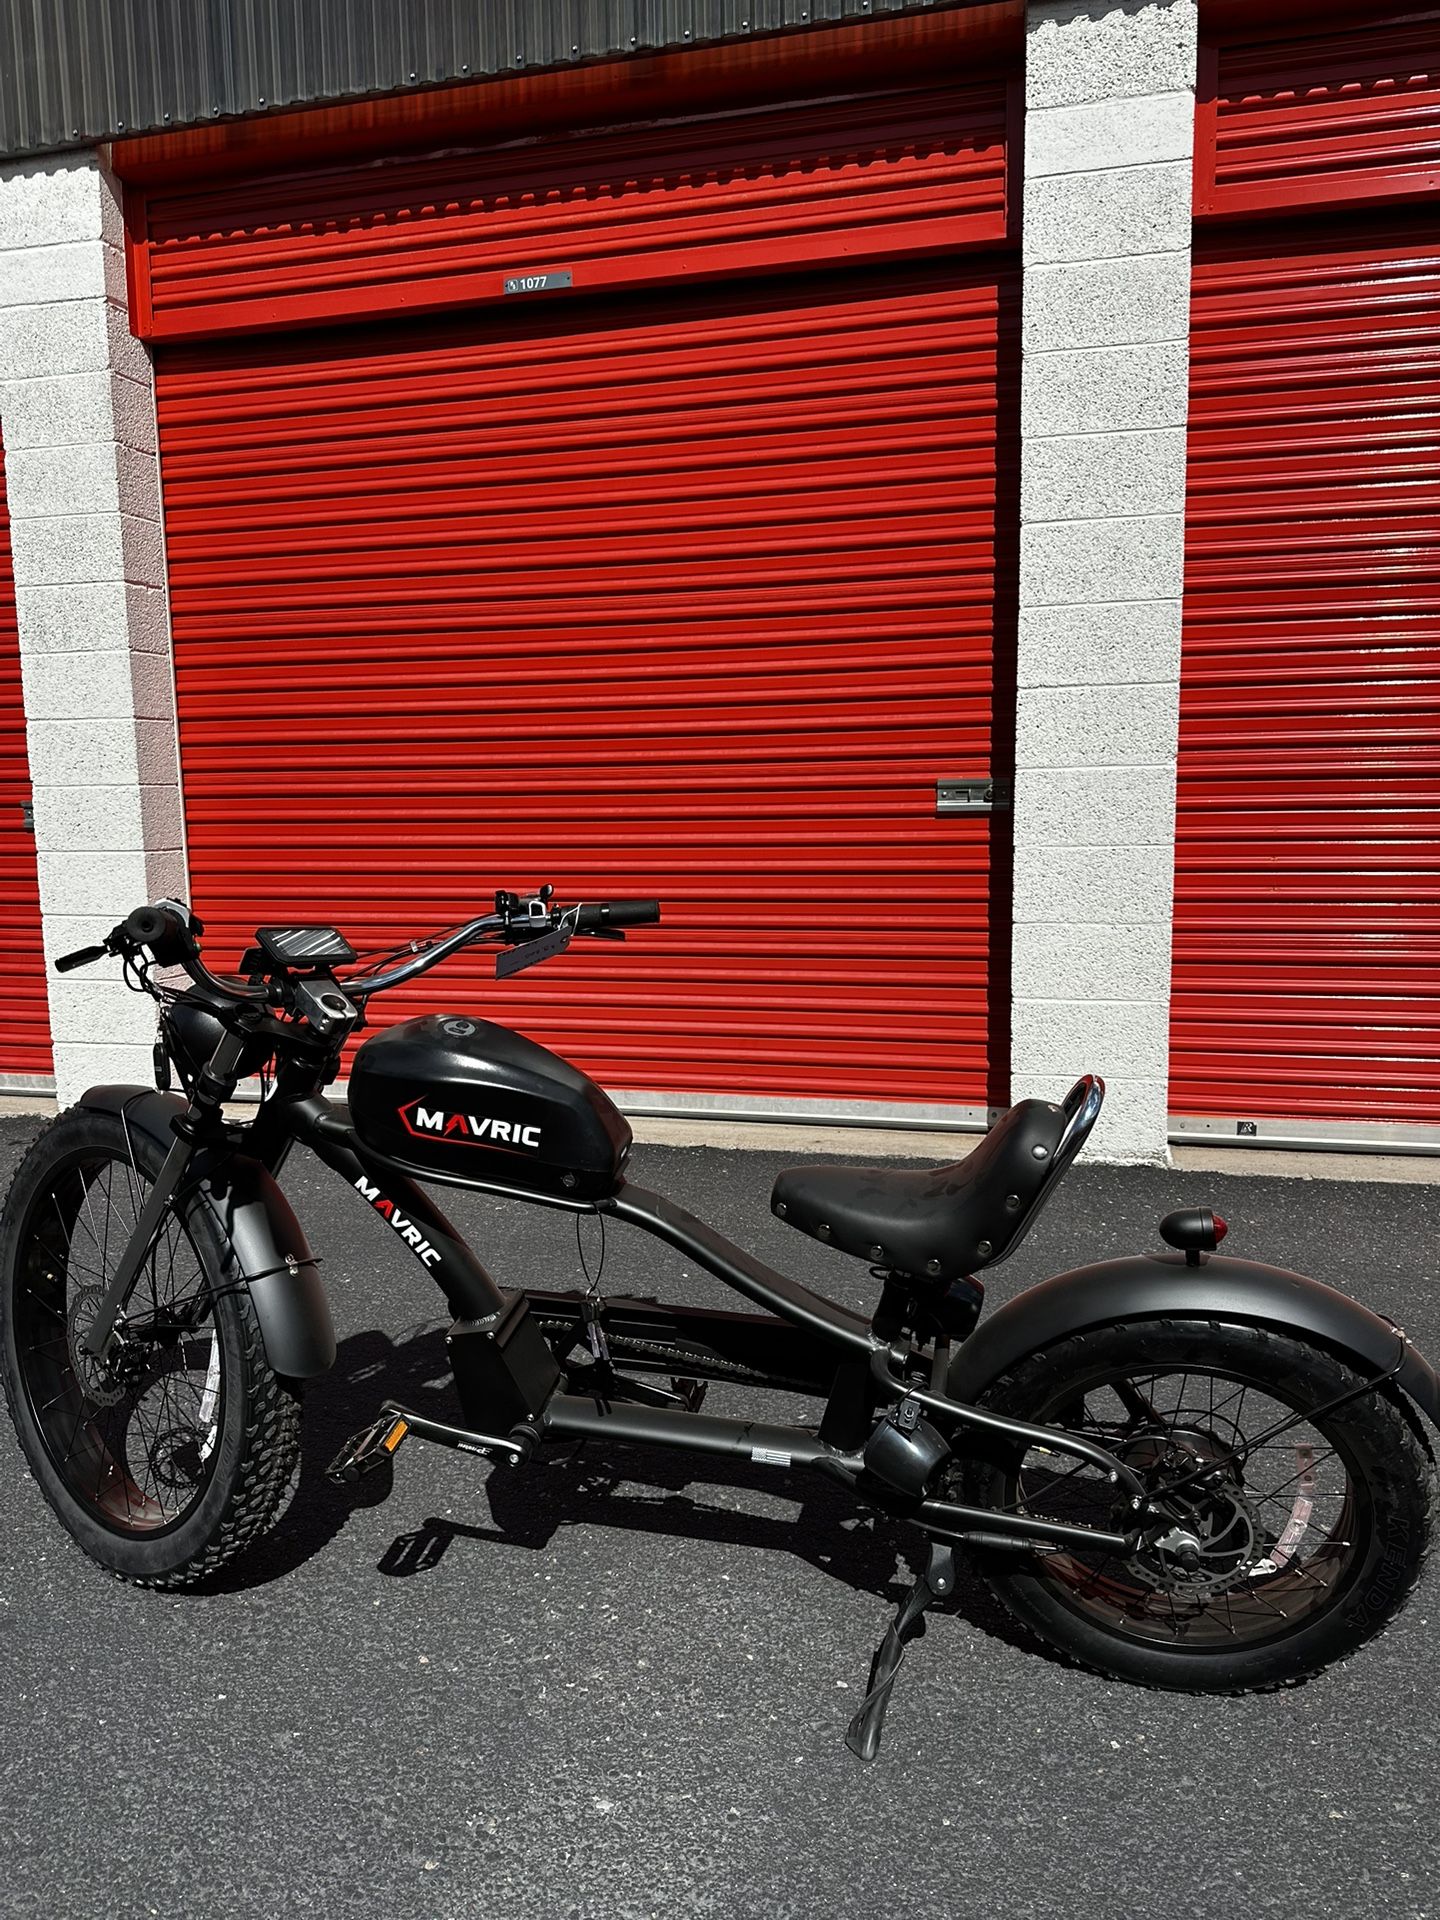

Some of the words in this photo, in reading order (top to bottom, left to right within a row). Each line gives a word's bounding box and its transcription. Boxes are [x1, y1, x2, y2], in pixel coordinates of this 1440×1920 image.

[520, 275, 547, 290] 1077
[415, 1107, 542, 1148] MAVRIC
[354, 1175, 442, 1268] MAVRIC
[1346, 1513, 1410, 1628] KENDA
